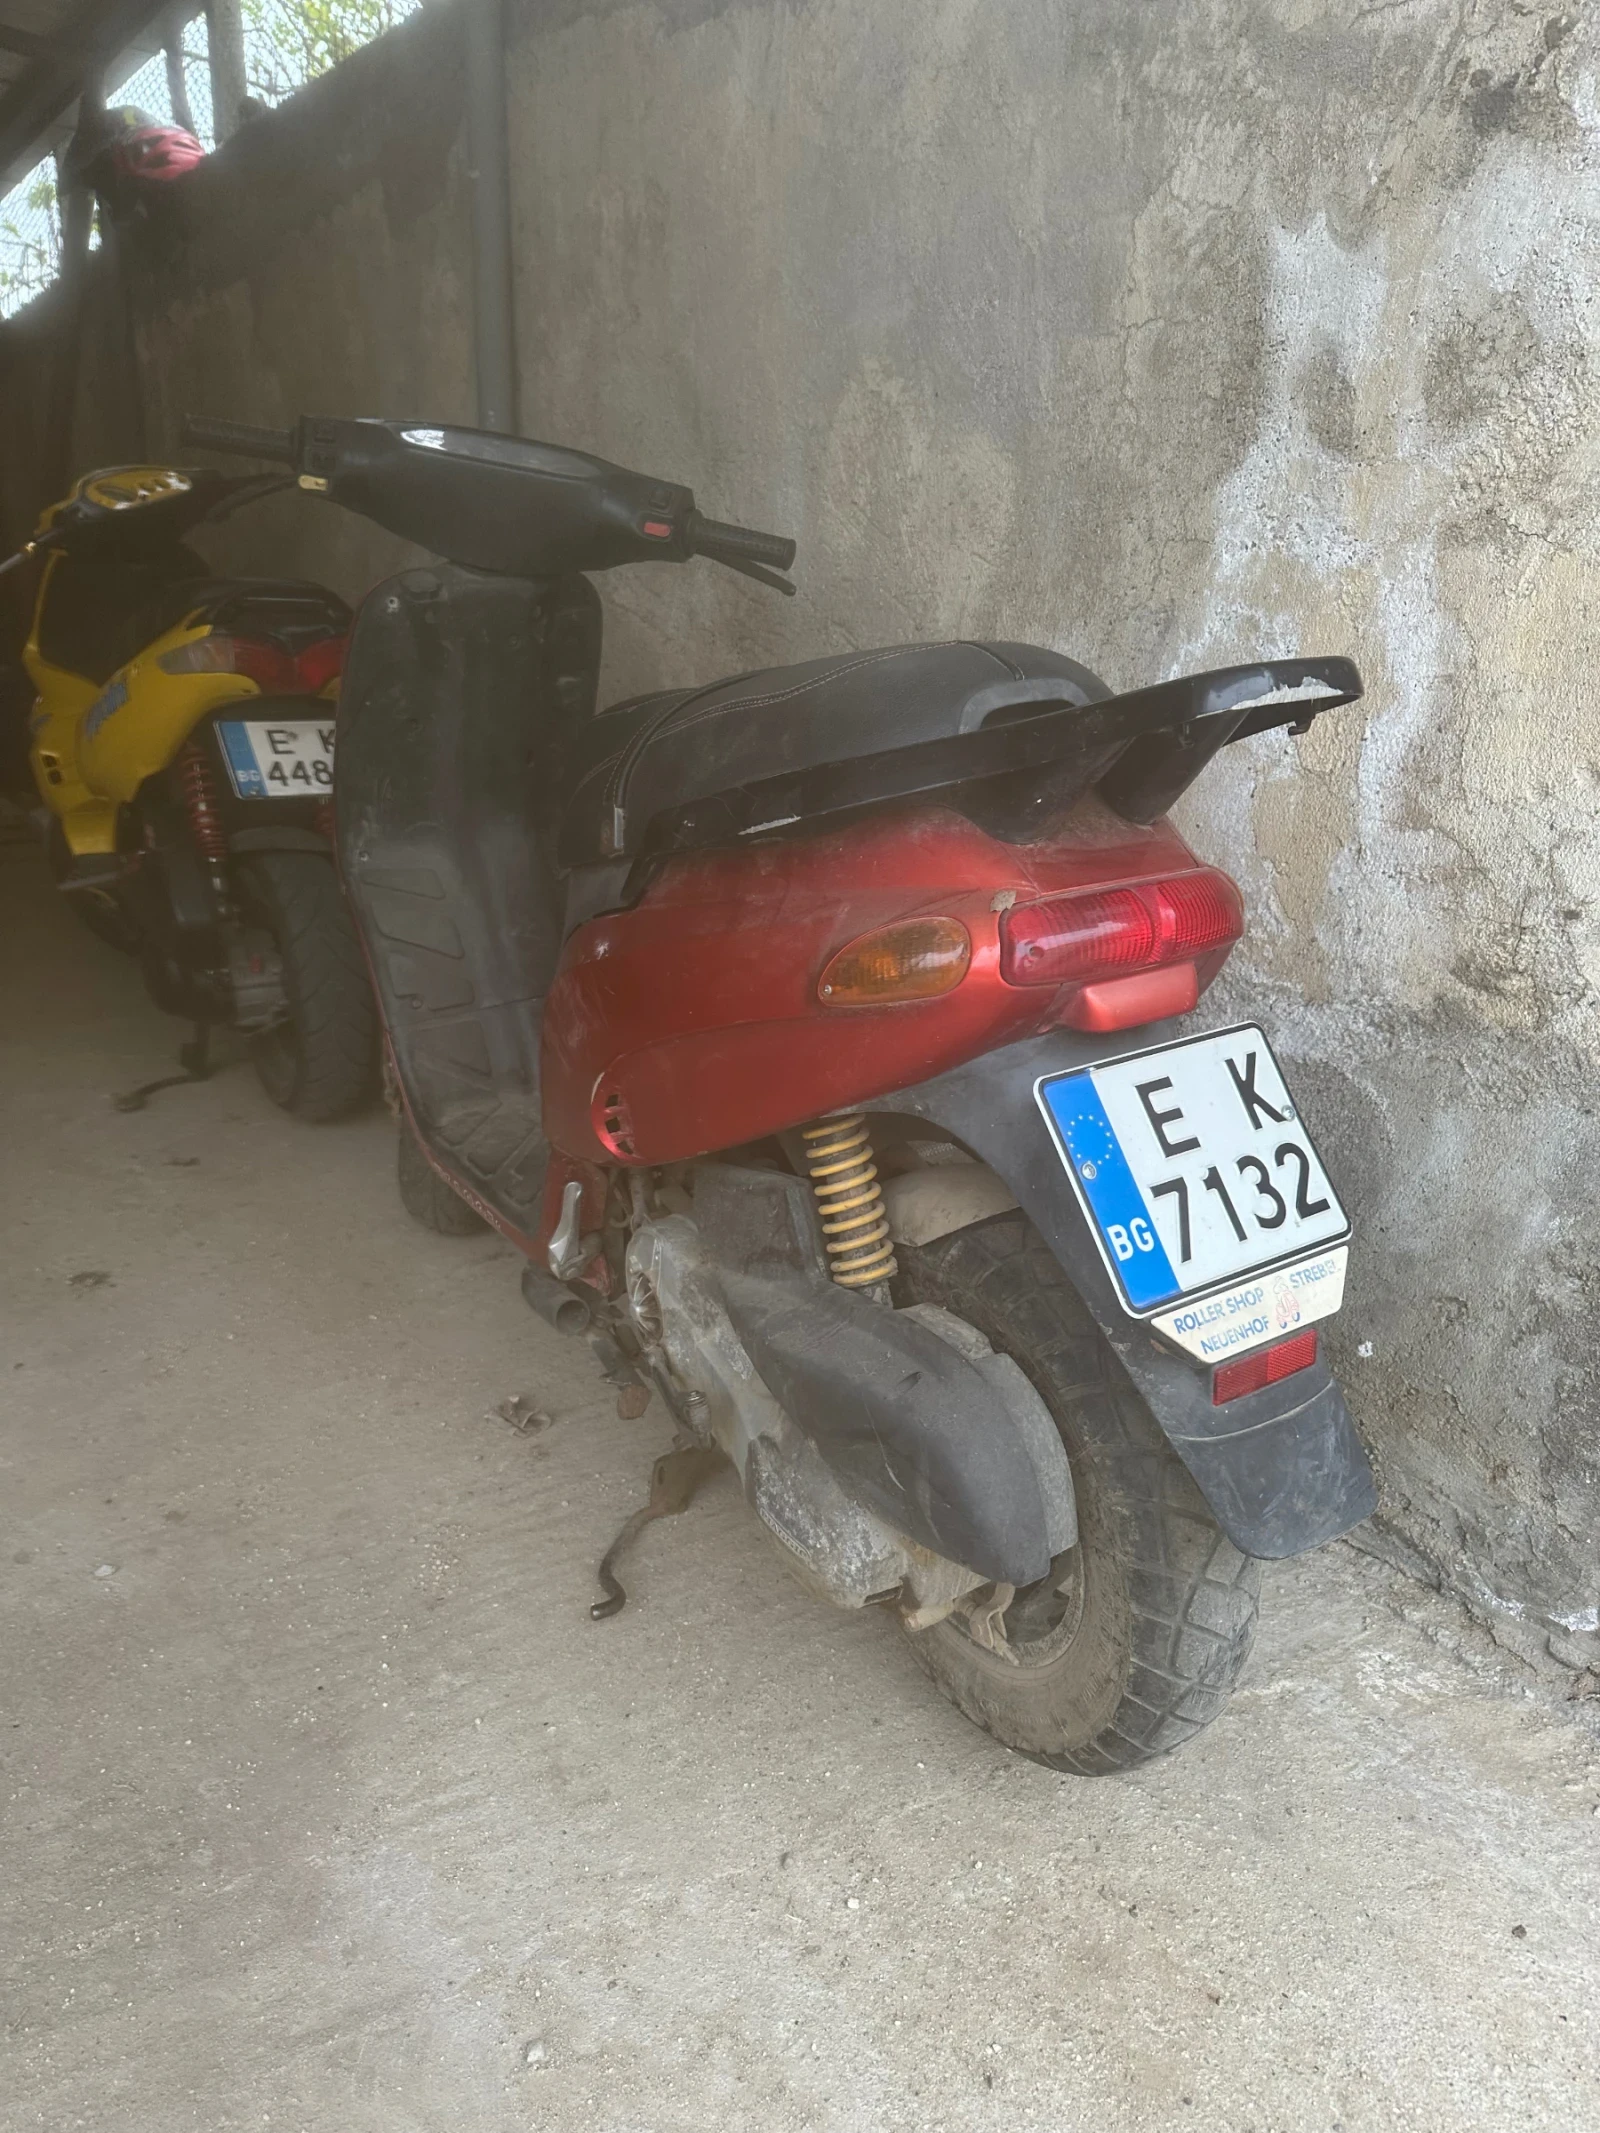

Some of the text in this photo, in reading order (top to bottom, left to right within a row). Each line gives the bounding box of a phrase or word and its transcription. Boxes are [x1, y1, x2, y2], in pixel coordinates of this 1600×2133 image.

[267, 729, 295, 755] E
[236, 770, 261, 782] BG
[1135, 1051, 1287, 1158] E K
[1149, 1142, 1331, 1264] 7132
[1107, 1218, 1155, 1261] BG
[1173, 1302, 1225, 1335] ROLLER
[1226, 1286, 1265, 1315] SHOP
[1200, 1315, 1270, 1355] NEUENHOF
